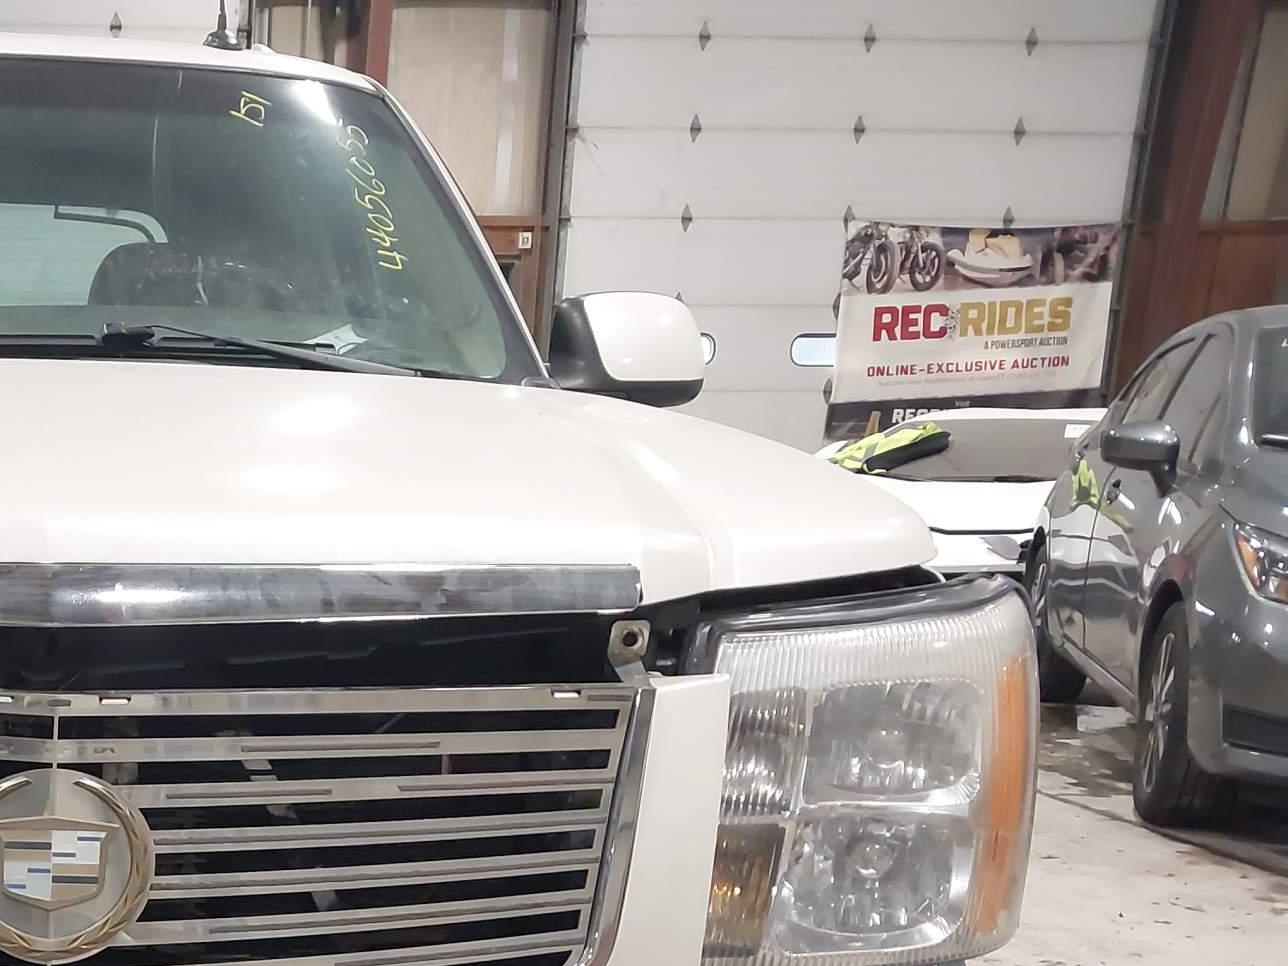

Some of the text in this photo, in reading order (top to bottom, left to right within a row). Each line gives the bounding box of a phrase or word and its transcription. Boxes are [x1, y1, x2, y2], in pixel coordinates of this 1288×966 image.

[336, 117, 409, 270] 44056055
[872, 297, 1073, 342] REC RIDES
[983, 336, 1068, 350] A POWERSPORT AUCTION
[866, 355, 1070, 378] ONLINE-EXCLUSIVE AUCTION
